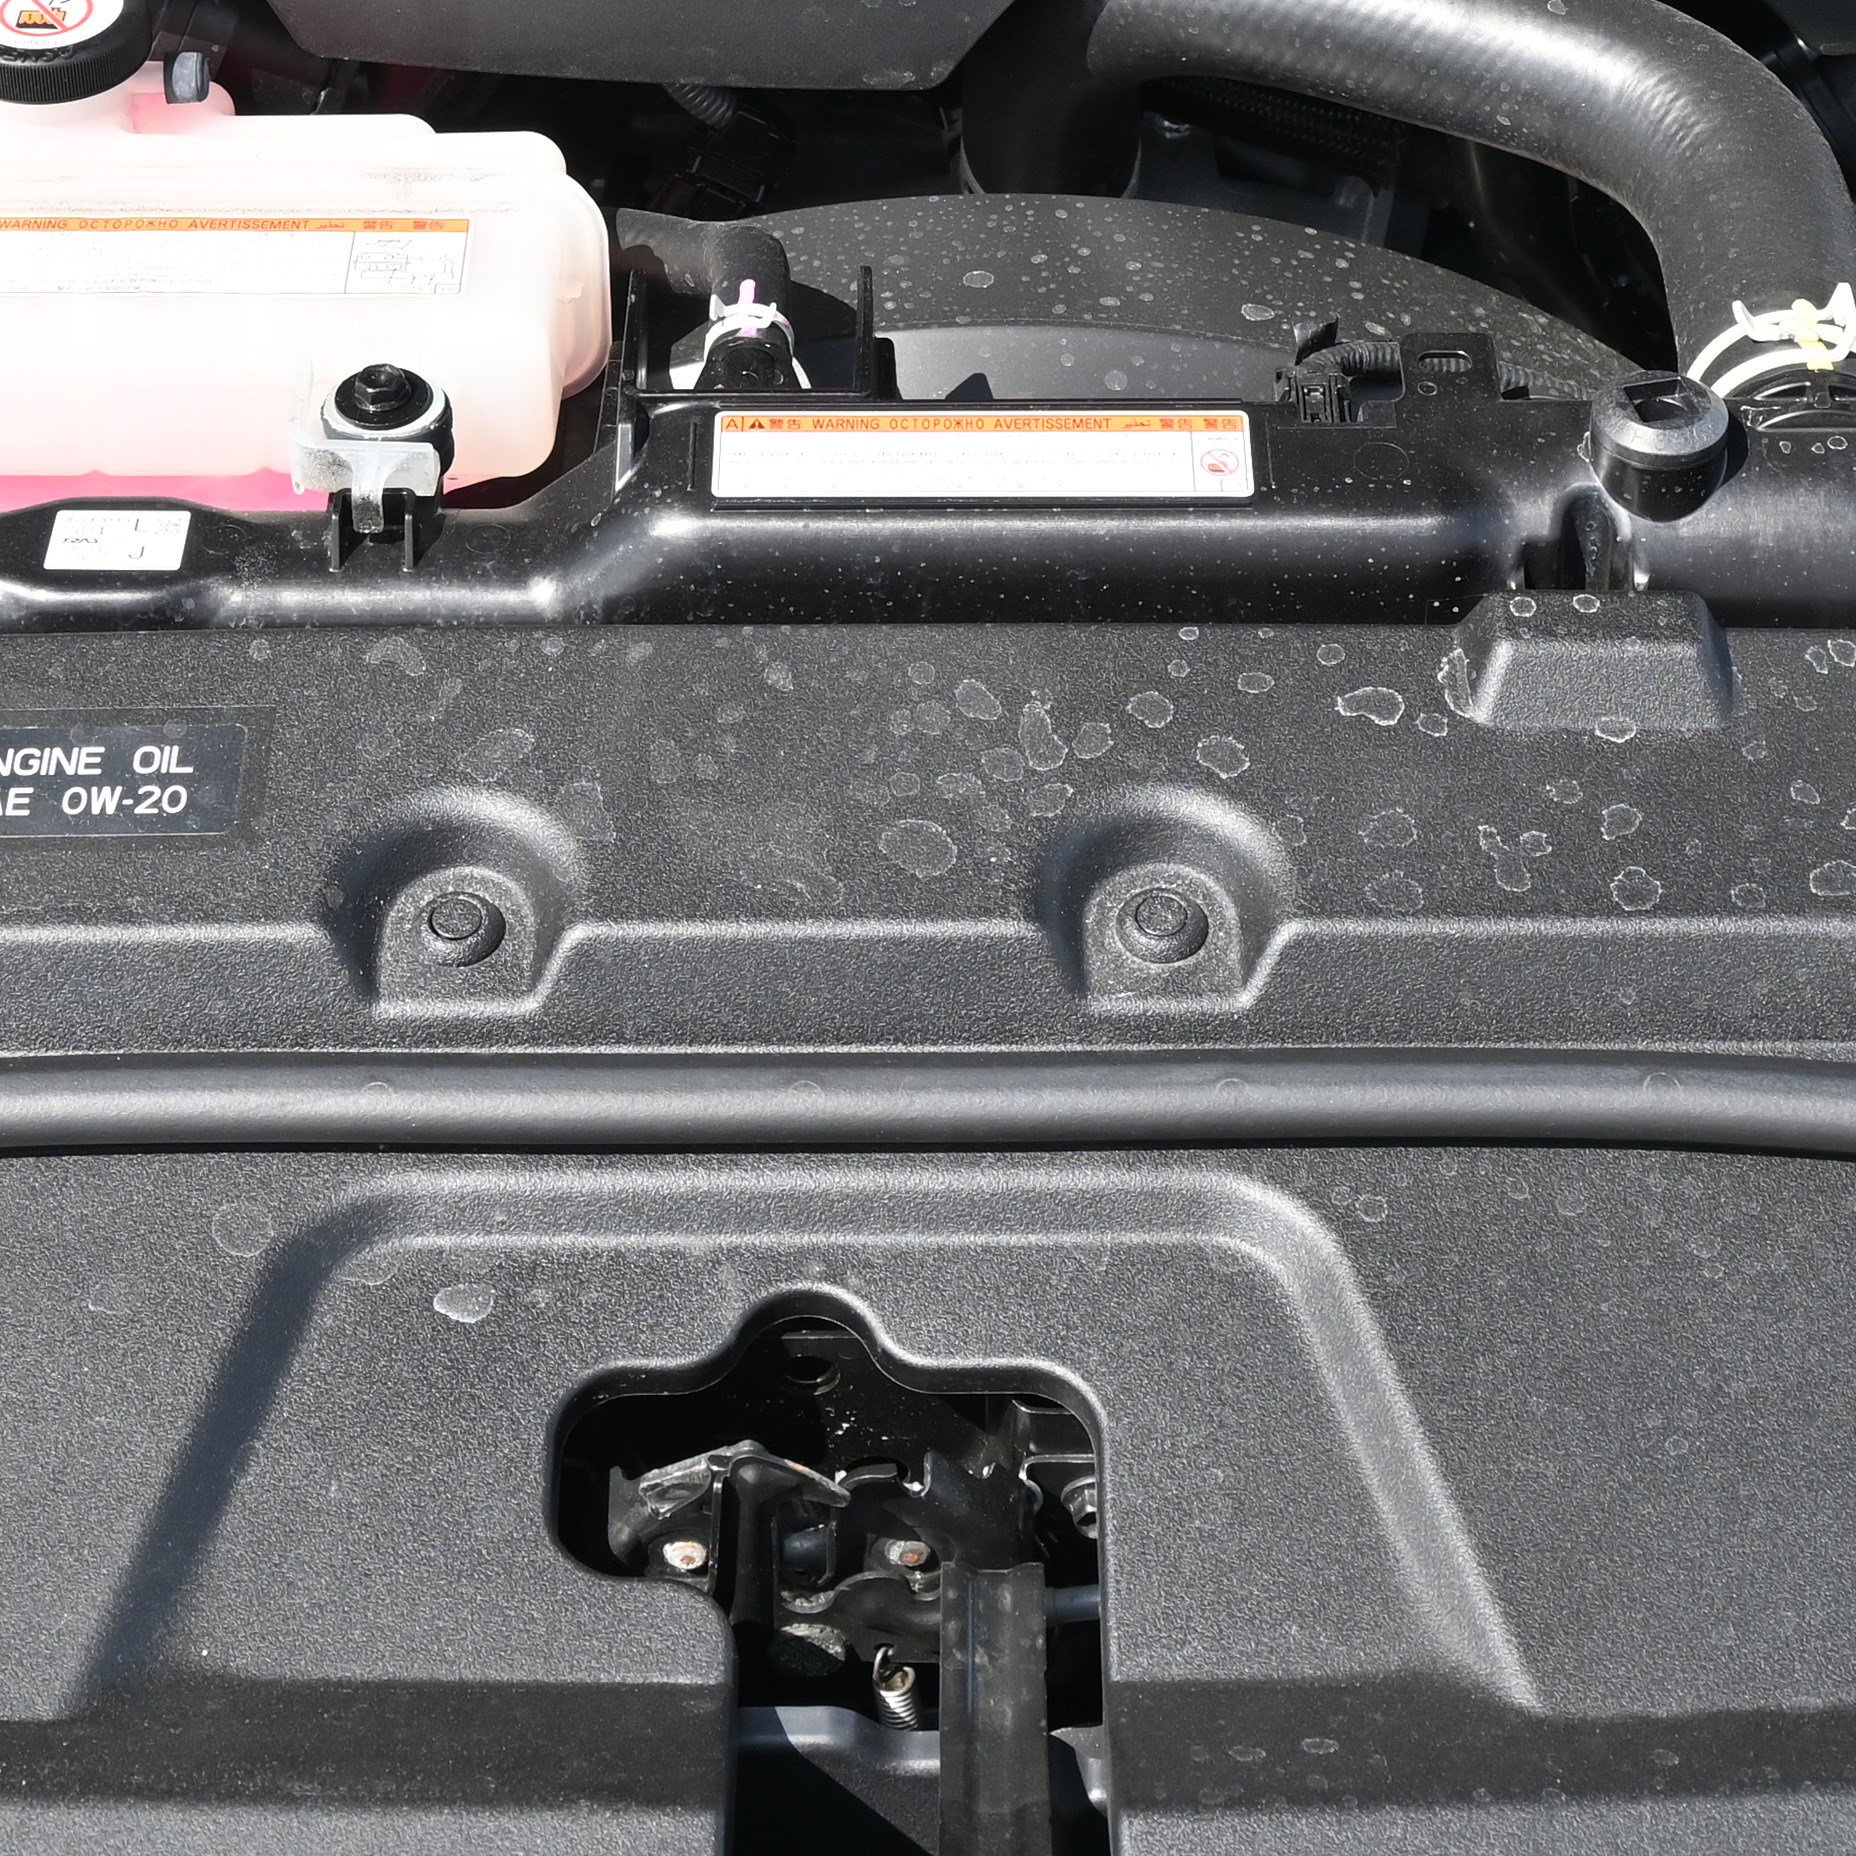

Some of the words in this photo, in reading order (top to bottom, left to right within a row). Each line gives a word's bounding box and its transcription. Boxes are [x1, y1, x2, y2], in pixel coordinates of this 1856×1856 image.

[78, 219, 179, 230] ОСТОРОЖНО
[187, 219, 311, 230] AVERTISSEMENT
[725, 418, 740, 430] A
[812, 418, 880, 430] WARNING
[889, 418, 985, 430] ОСТОРОЖНО
[993, 418, 1112, 430] AVERTISSEMENT
[132, 744, 195, 775] OIL
[60, 784, 189, 816] 0W-20
